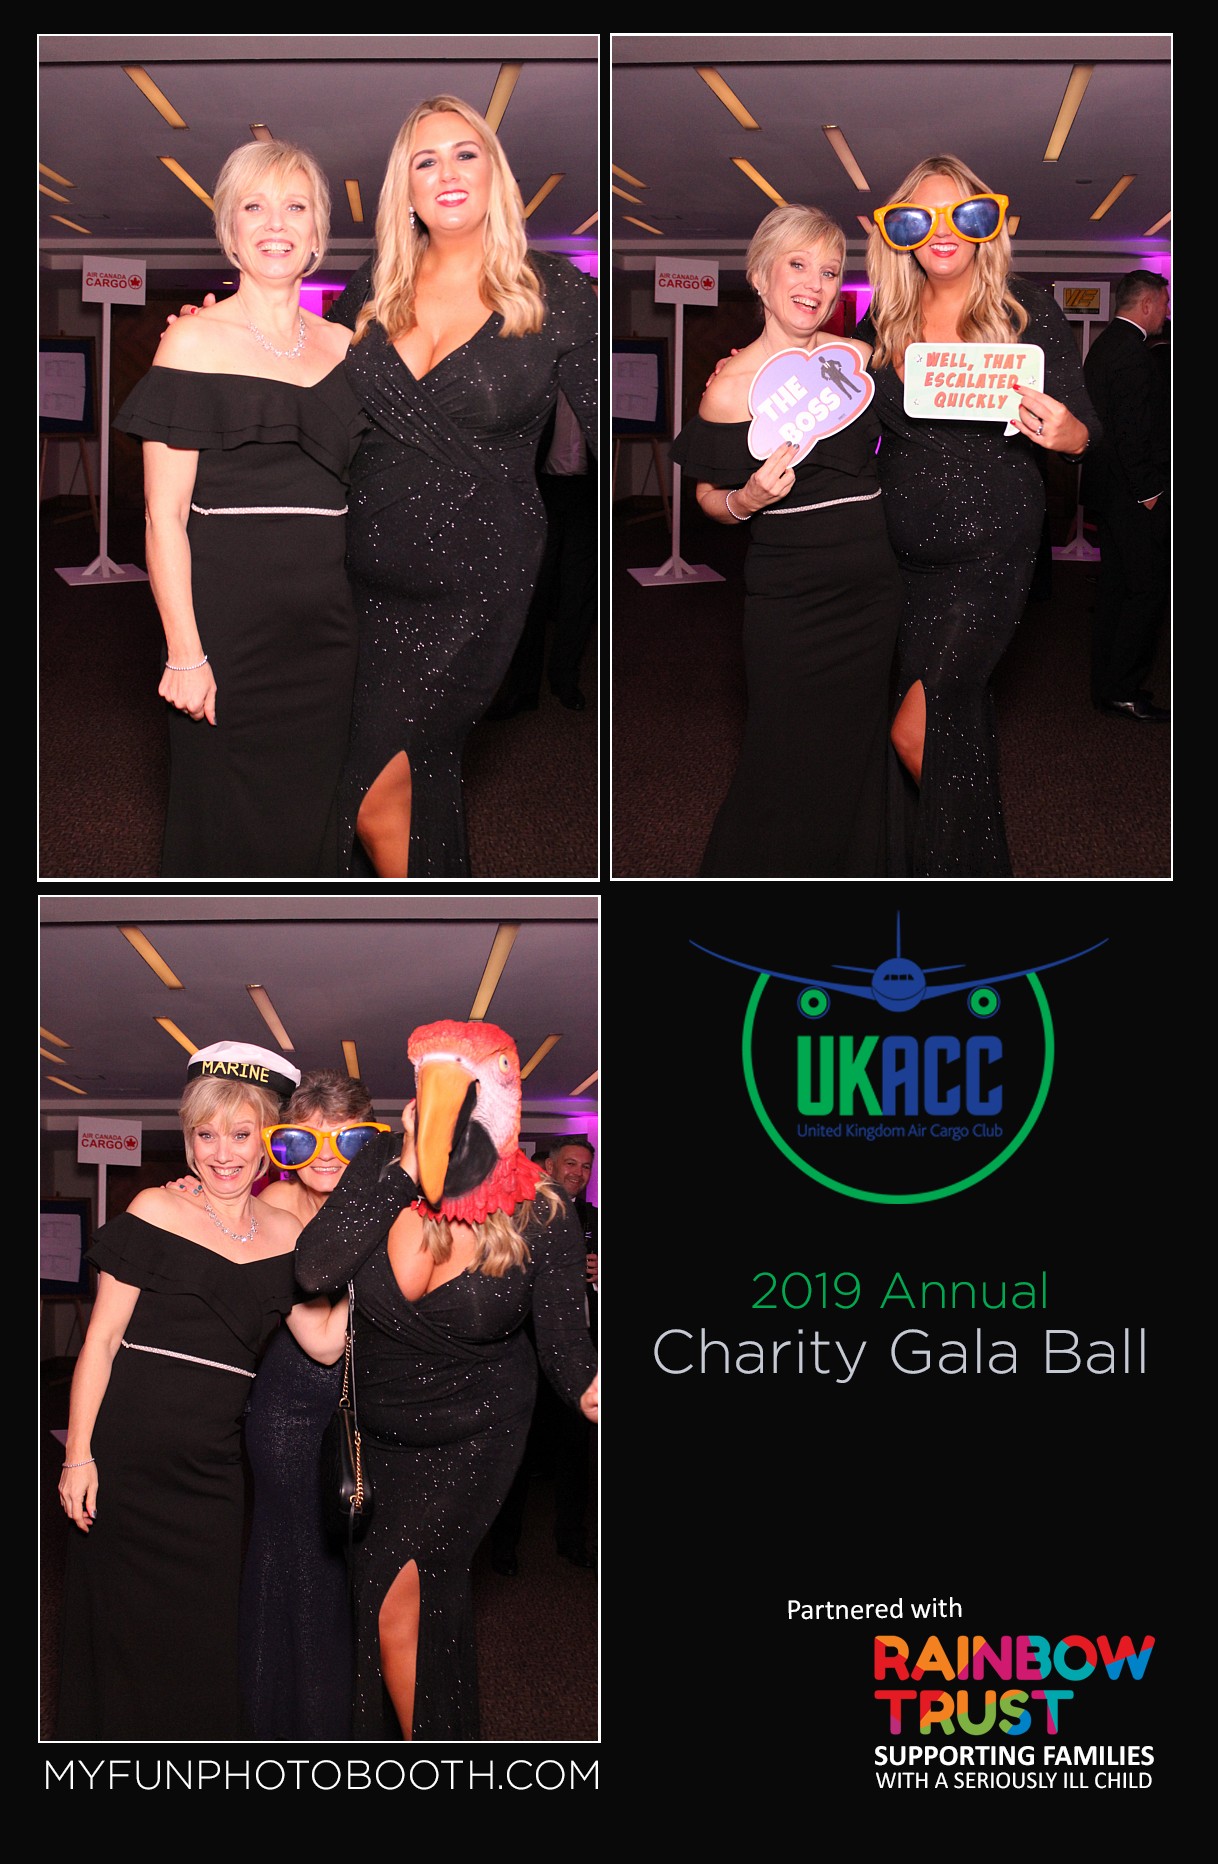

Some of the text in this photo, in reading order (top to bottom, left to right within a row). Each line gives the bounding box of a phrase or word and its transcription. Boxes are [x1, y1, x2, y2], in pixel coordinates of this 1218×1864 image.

[85, 277, 127, 289] CARGO
[99, 272, 127, 280] CANADA
[672, 273, 699, 281] CANADA
[658, 278, 700, 290] CARGO
[926, 352, 1027, 371] WELL, THAT
[924, 371, 1019, 389] ESCALATED
[756, 375, 809, 422] THE
[933, 391, 1008, 409] QUICKLY
[778, 386, 841, 446] BOSS
[201, 1060, 270, 1083] MARINE
[81, 1138, 123, 1150] CARGO
[95, 1133, 122, 1141] CANADA
